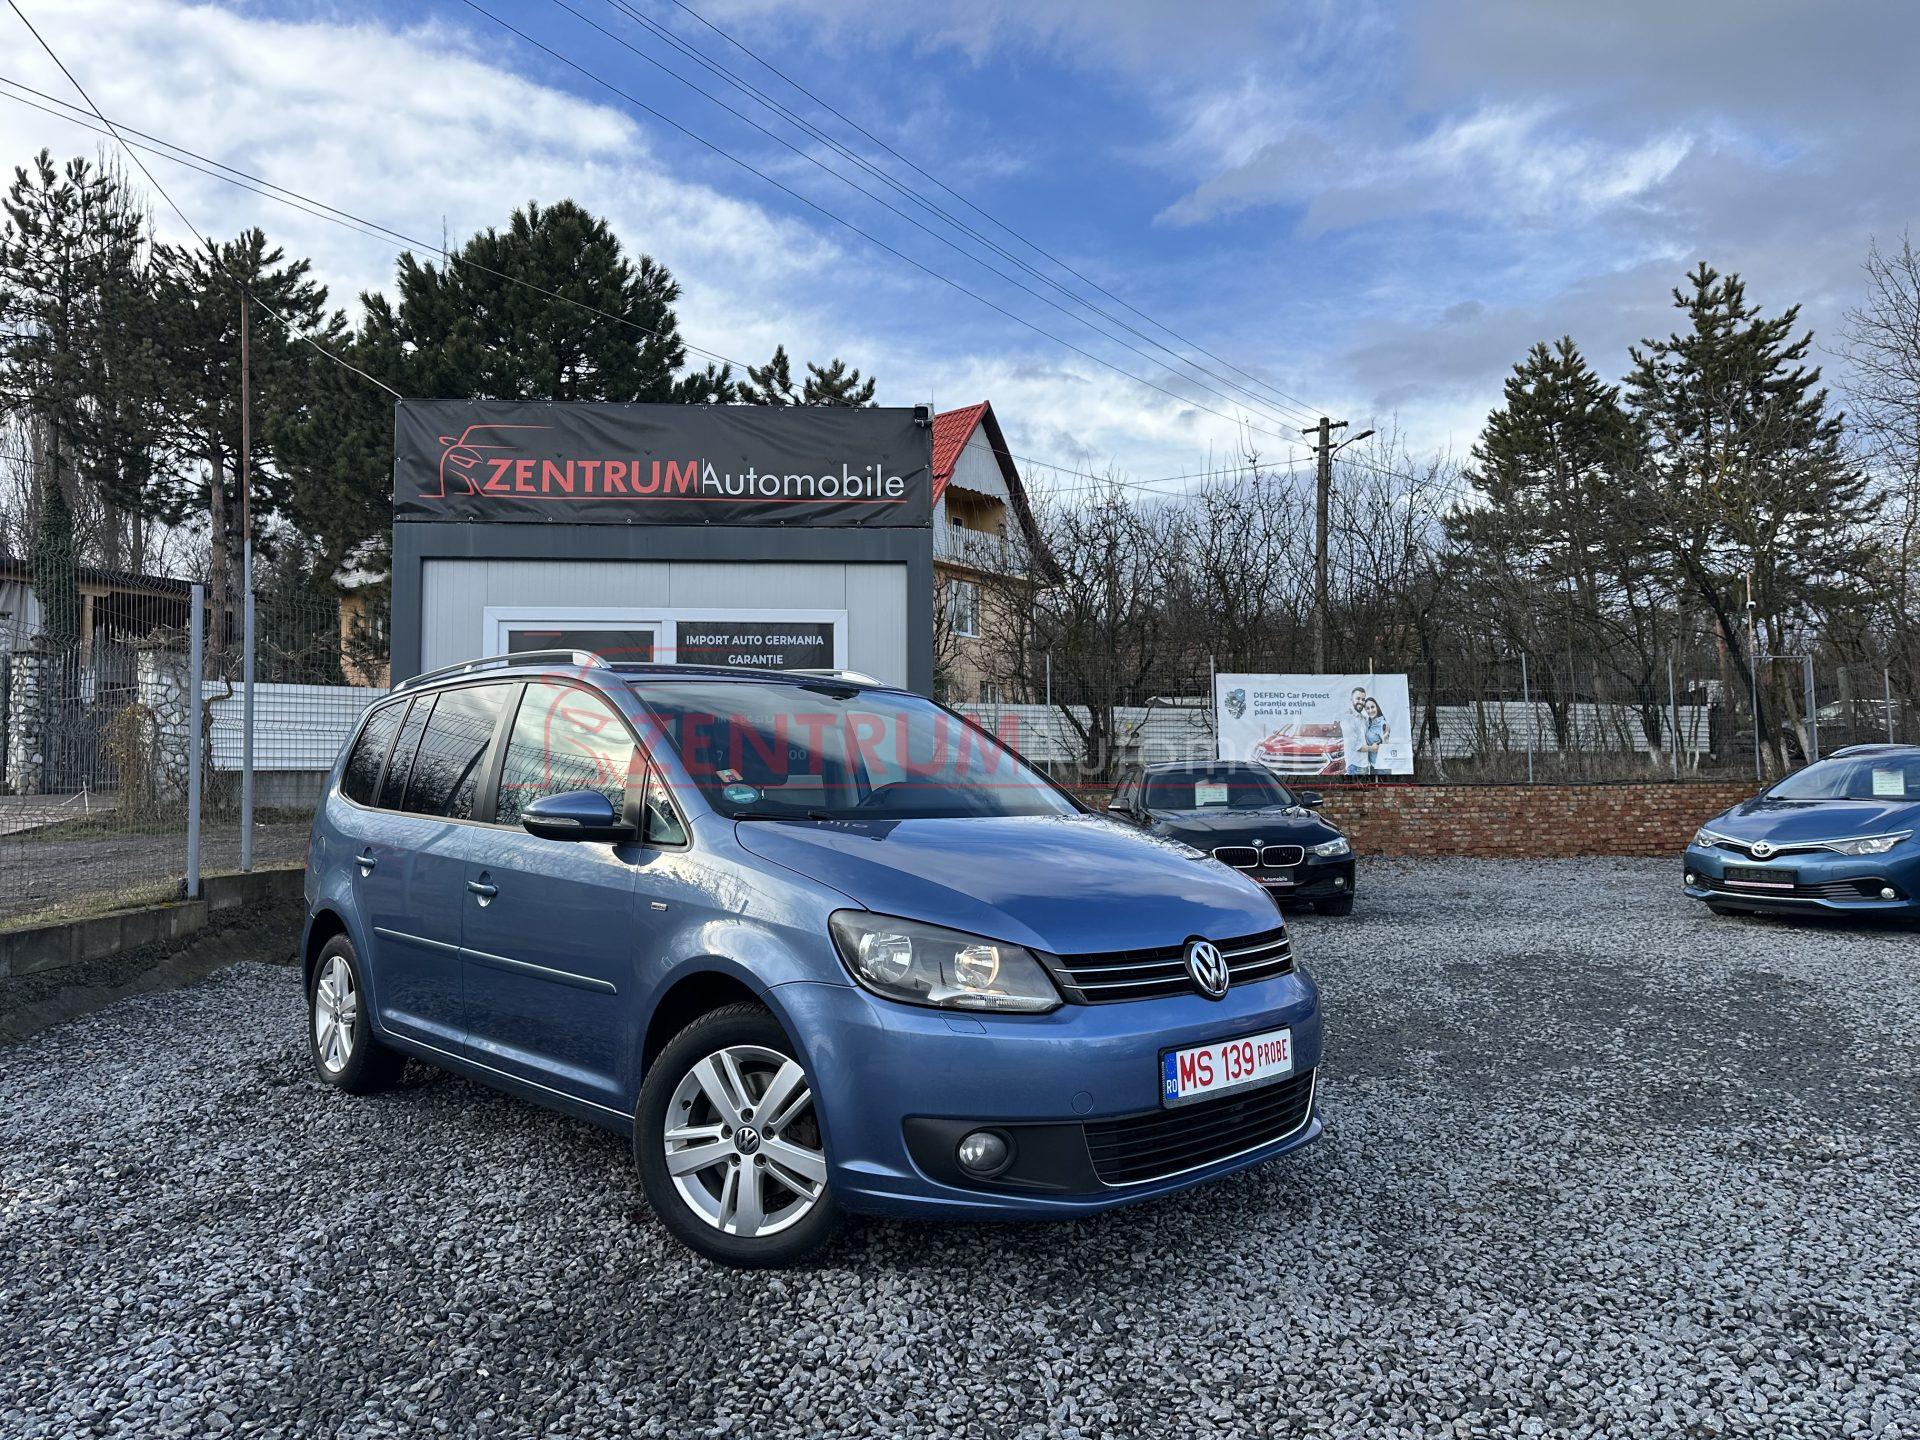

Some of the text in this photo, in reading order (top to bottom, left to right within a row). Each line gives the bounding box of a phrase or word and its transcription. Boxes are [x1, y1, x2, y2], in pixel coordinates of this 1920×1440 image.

[483, 458, 905, 497] ZENTRUM Automobile
[686, 635, 824, 645] IMPORT AUTO GERMANIA
[728, 655, 783, 667] GARANȚIE
[1179, 1038, 1288, 1092] MS 139 PROBE
[1166, 1078, 1178, 1095] RO
